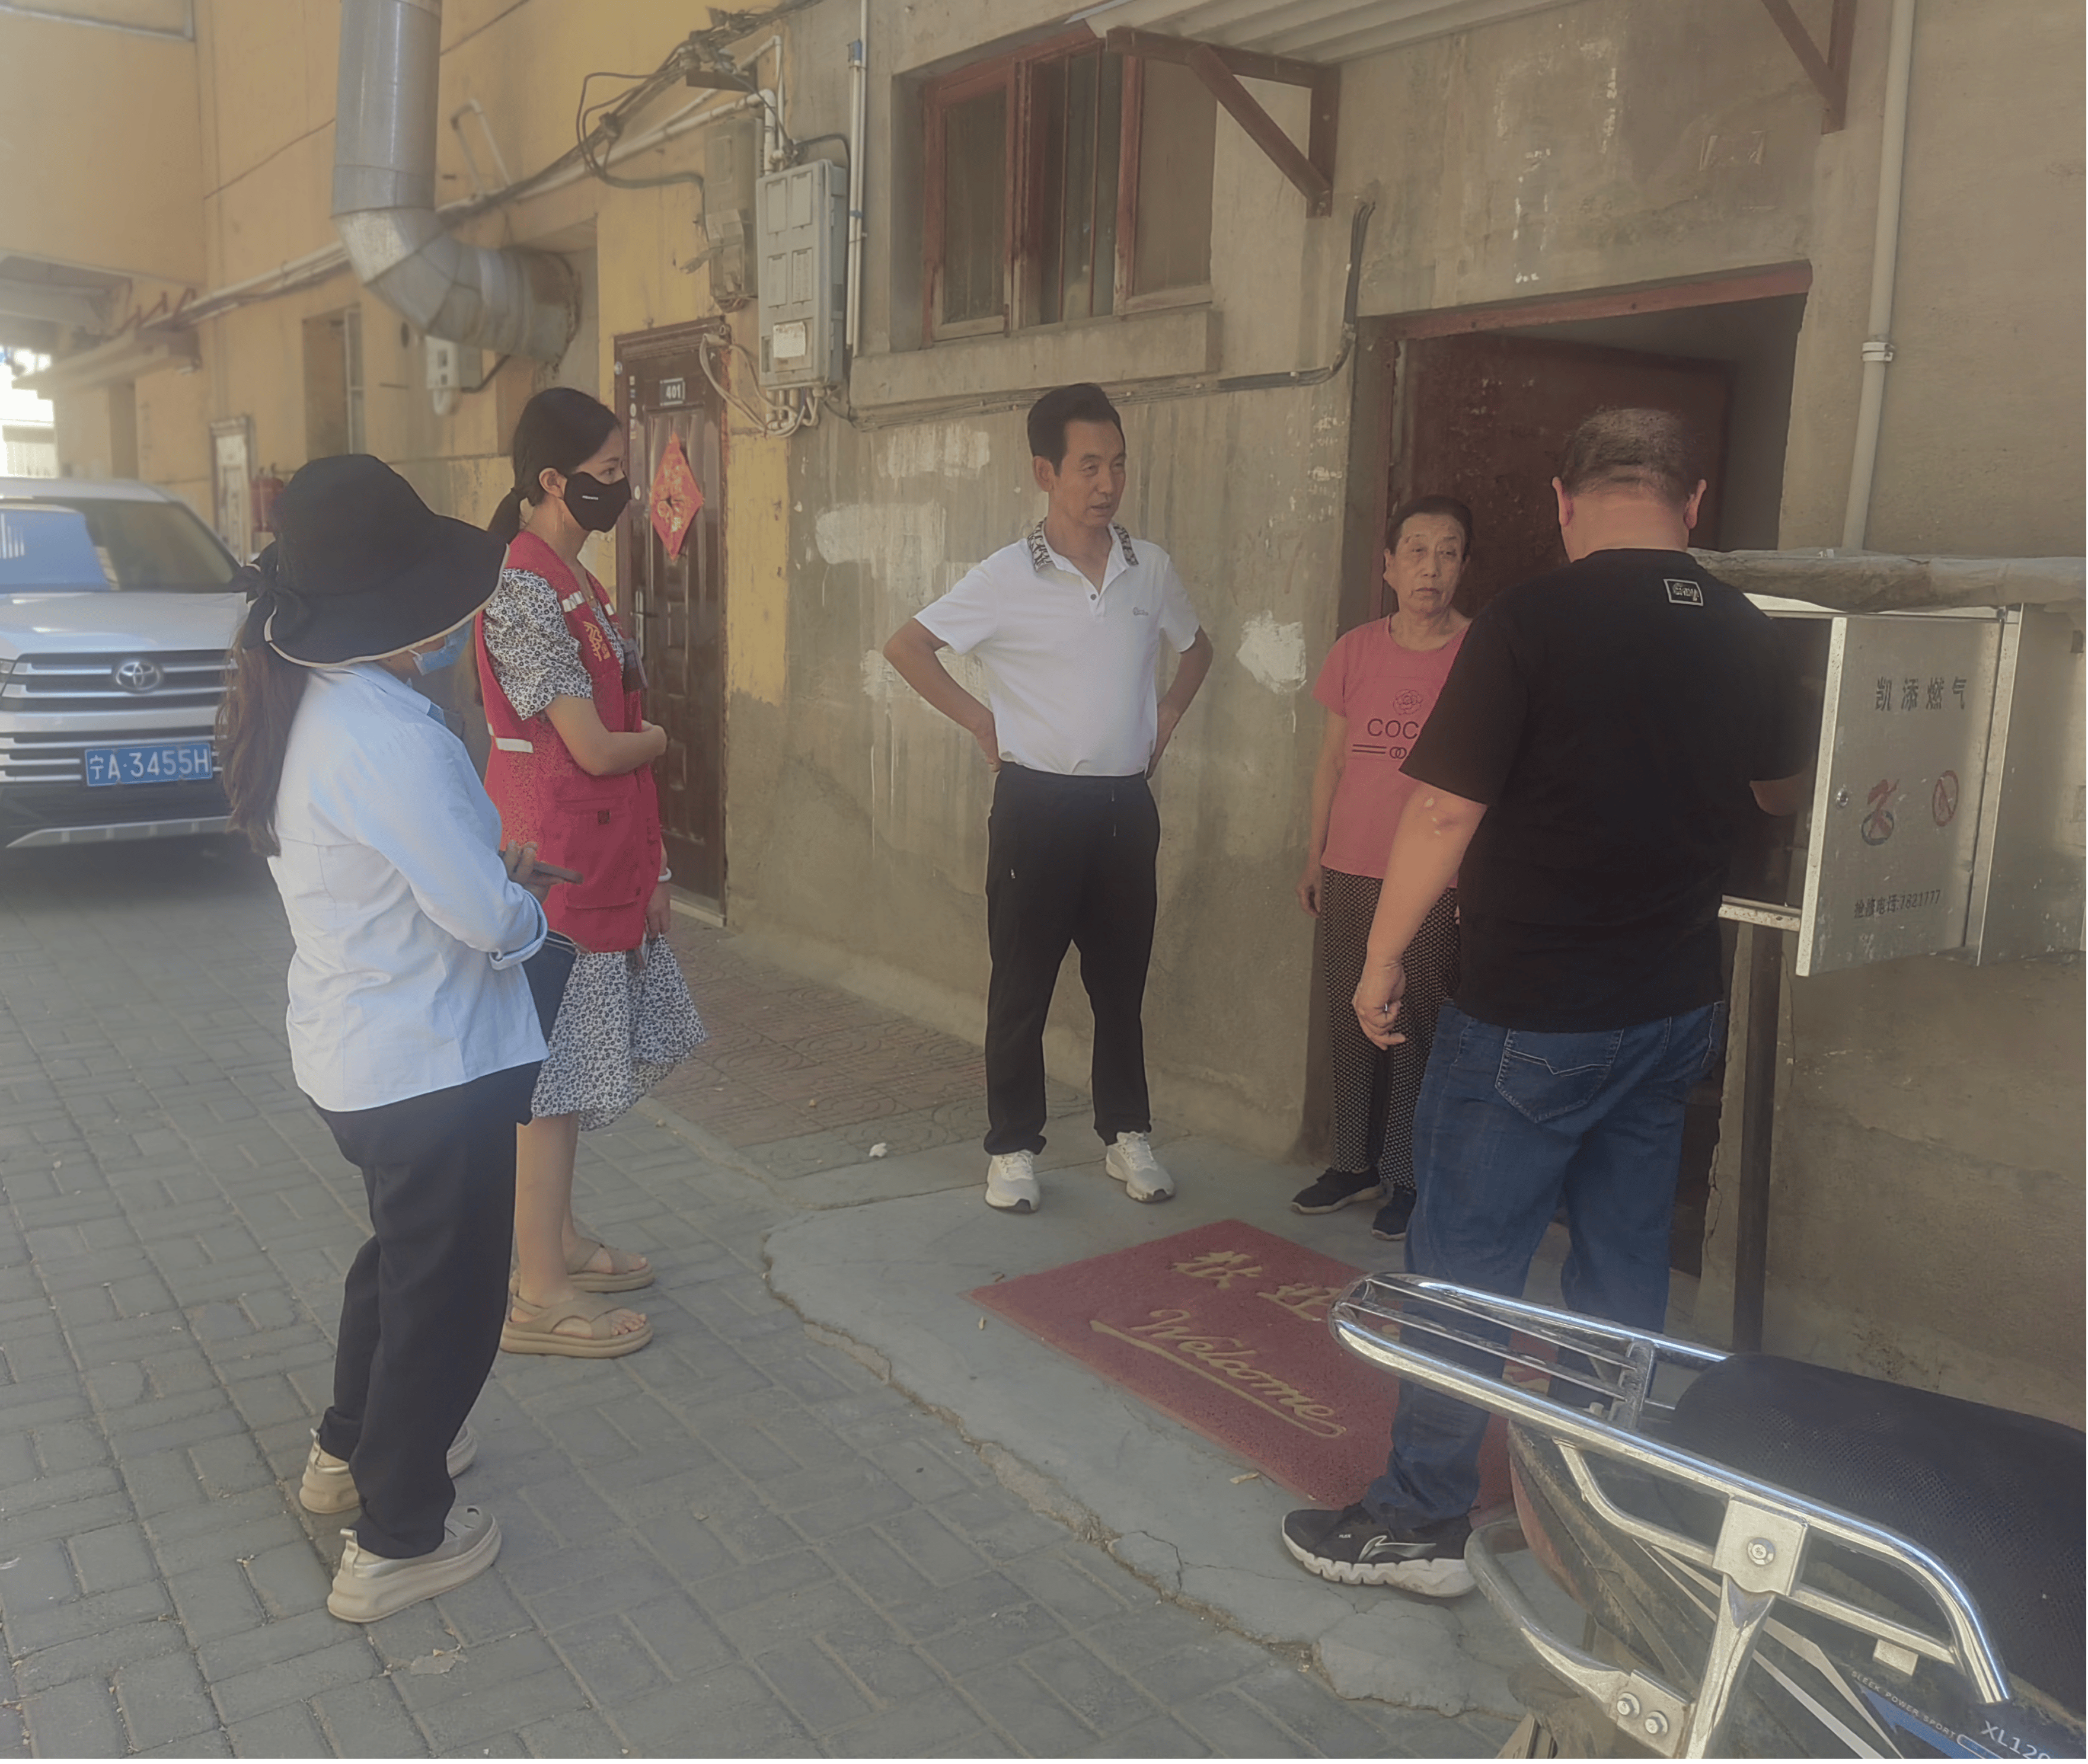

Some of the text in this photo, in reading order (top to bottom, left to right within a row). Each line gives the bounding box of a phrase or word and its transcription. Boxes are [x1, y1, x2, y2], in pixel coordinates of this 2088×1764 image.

[666, 384, 681, 399] 401
[1875, 676, 1967, 711] 凯添燃气
[1367, 718, 1419, 739] COC
[1126, 1308, 1339, 1423] Welcome
[1851, 1670, 1956, 1739] SLEEK POWER SPORT
